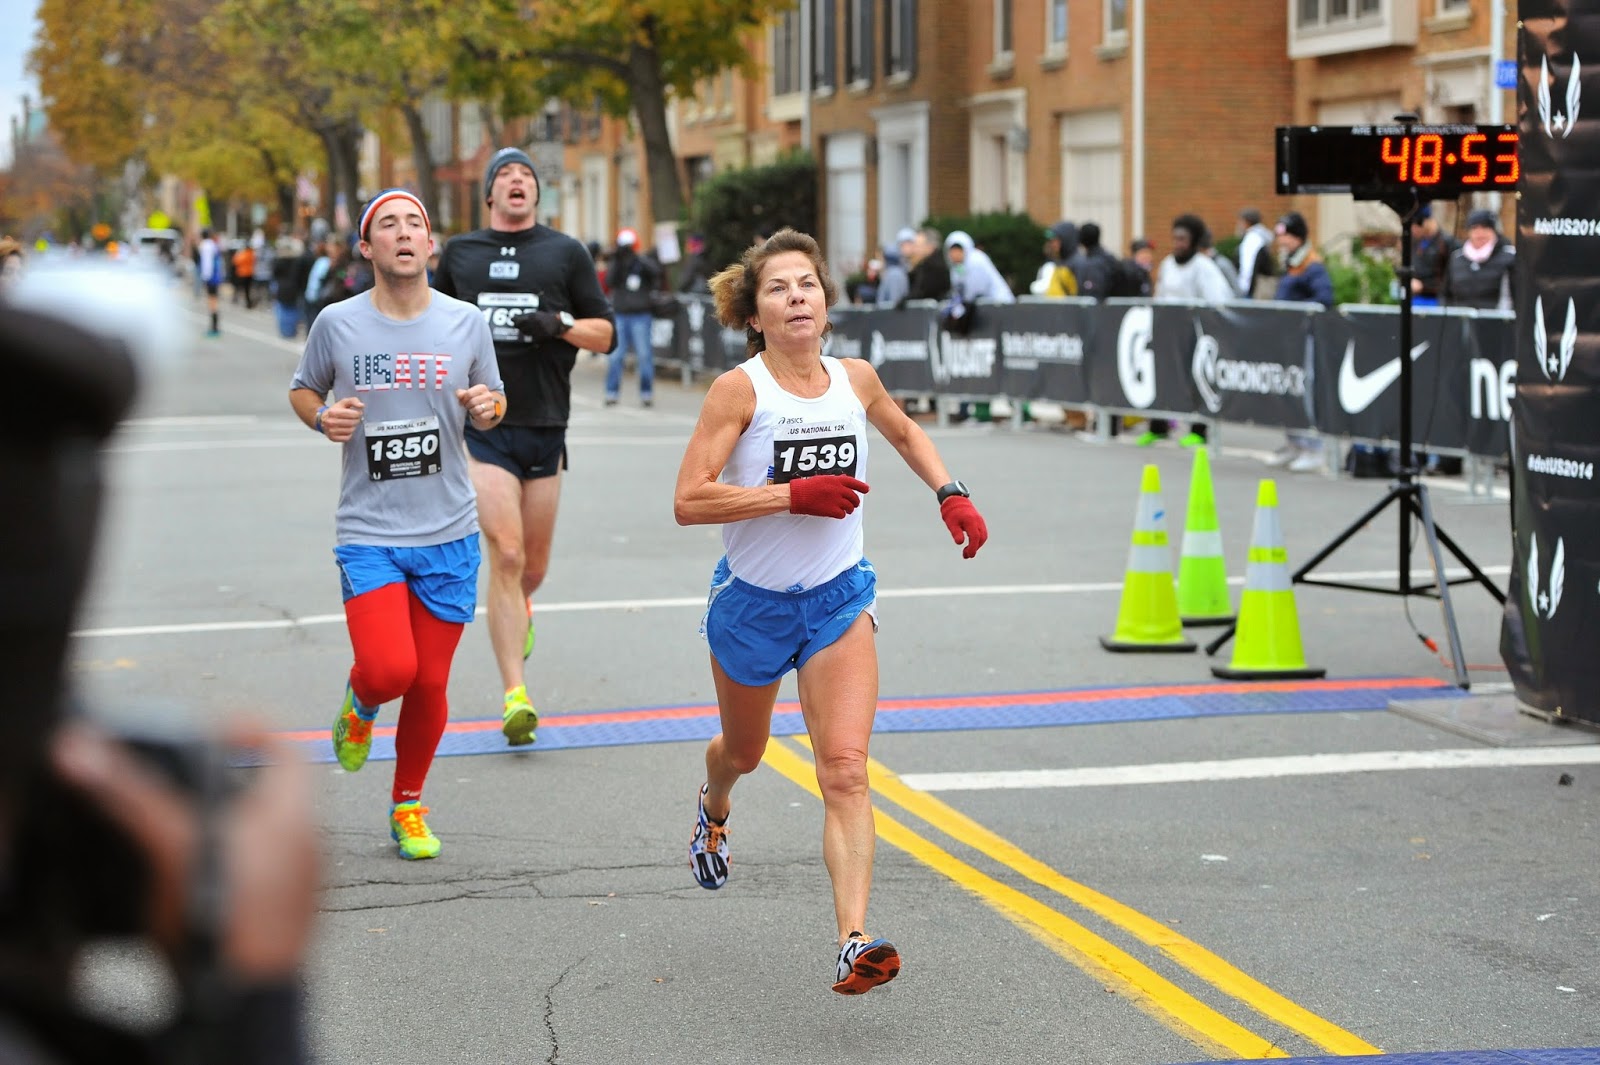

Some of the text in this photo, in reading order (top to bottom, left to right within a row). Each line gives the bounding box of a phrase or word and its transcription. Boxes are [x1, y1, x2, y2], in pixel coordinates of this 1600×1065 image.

[1411, 125, 1478, 136] PRODUCTIONS
[354, 352, 452, 392] USATF
[386, 423, 415, 431] NATIONAL
[800, 425, 832, 434] NATIONAL
[370, 434, 439, 462] 1350
[780, 442, 855, 472] 1539
